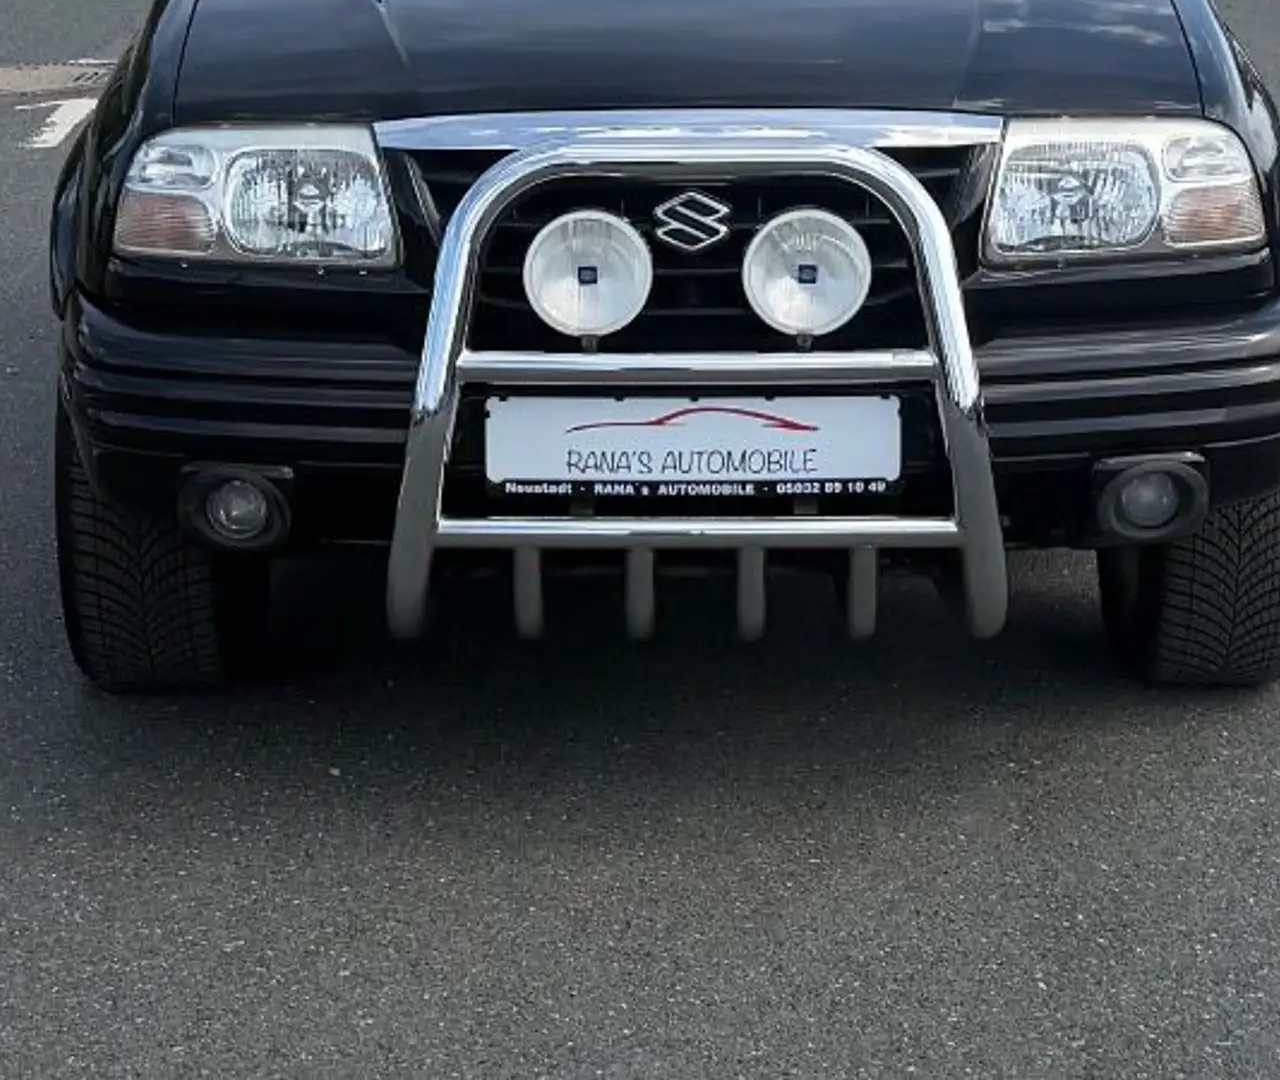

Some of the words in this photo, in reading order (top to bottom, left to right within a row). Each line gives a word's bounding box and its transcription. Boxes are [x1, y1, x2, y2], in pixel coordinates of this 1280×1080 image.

[566, 449, 653, 474] RANA'S
[660, 449, 819, 475] AUTOMOBILE
[505, 482, 572, 495] Neustadt
[657, 483, 755, 496] AUTOMOBILE
[776, 482, 820, 494] 05032
